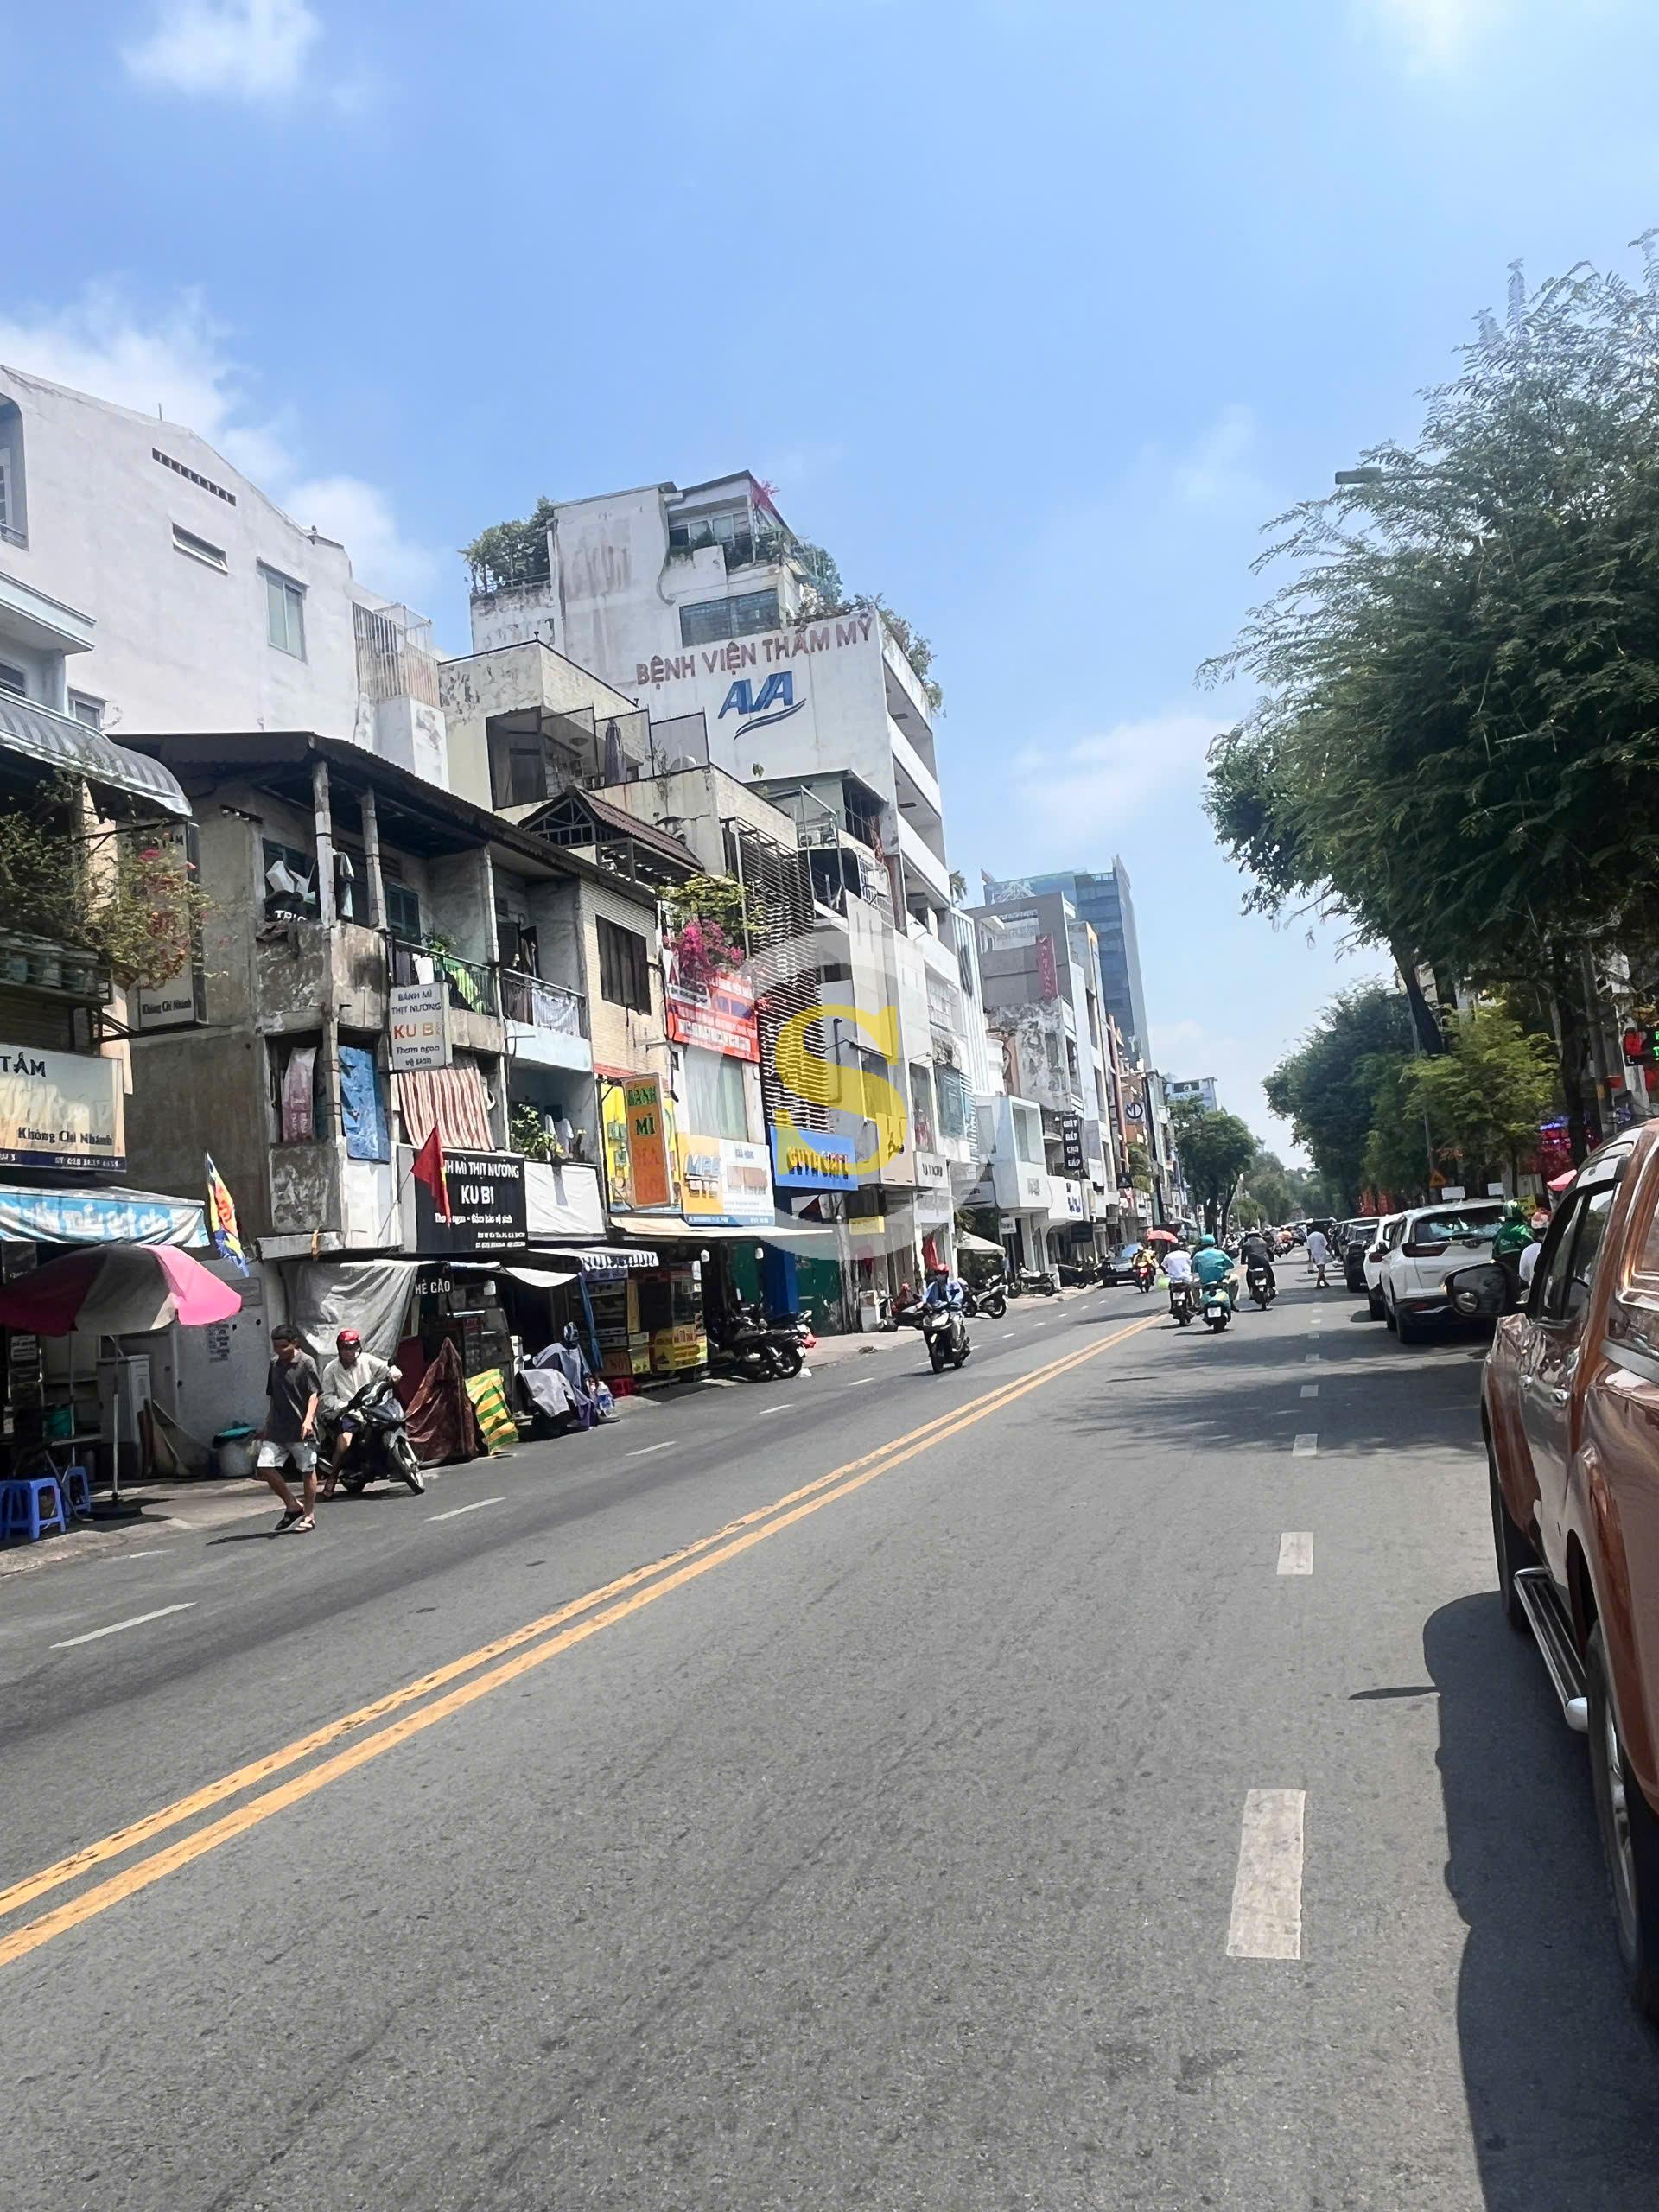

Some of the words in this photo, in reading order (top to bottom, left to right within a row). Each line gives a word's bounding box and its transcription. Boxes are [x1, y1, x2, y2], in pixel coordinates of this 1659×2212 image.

[636, 655, 696, 690] BỆNH
[702, 640, 757, 675] VIỆN
[717, 670, 794, 720] AVA
[461, 1185, 480, 1205] KU
[480, 1186, 494, 1205] BI
